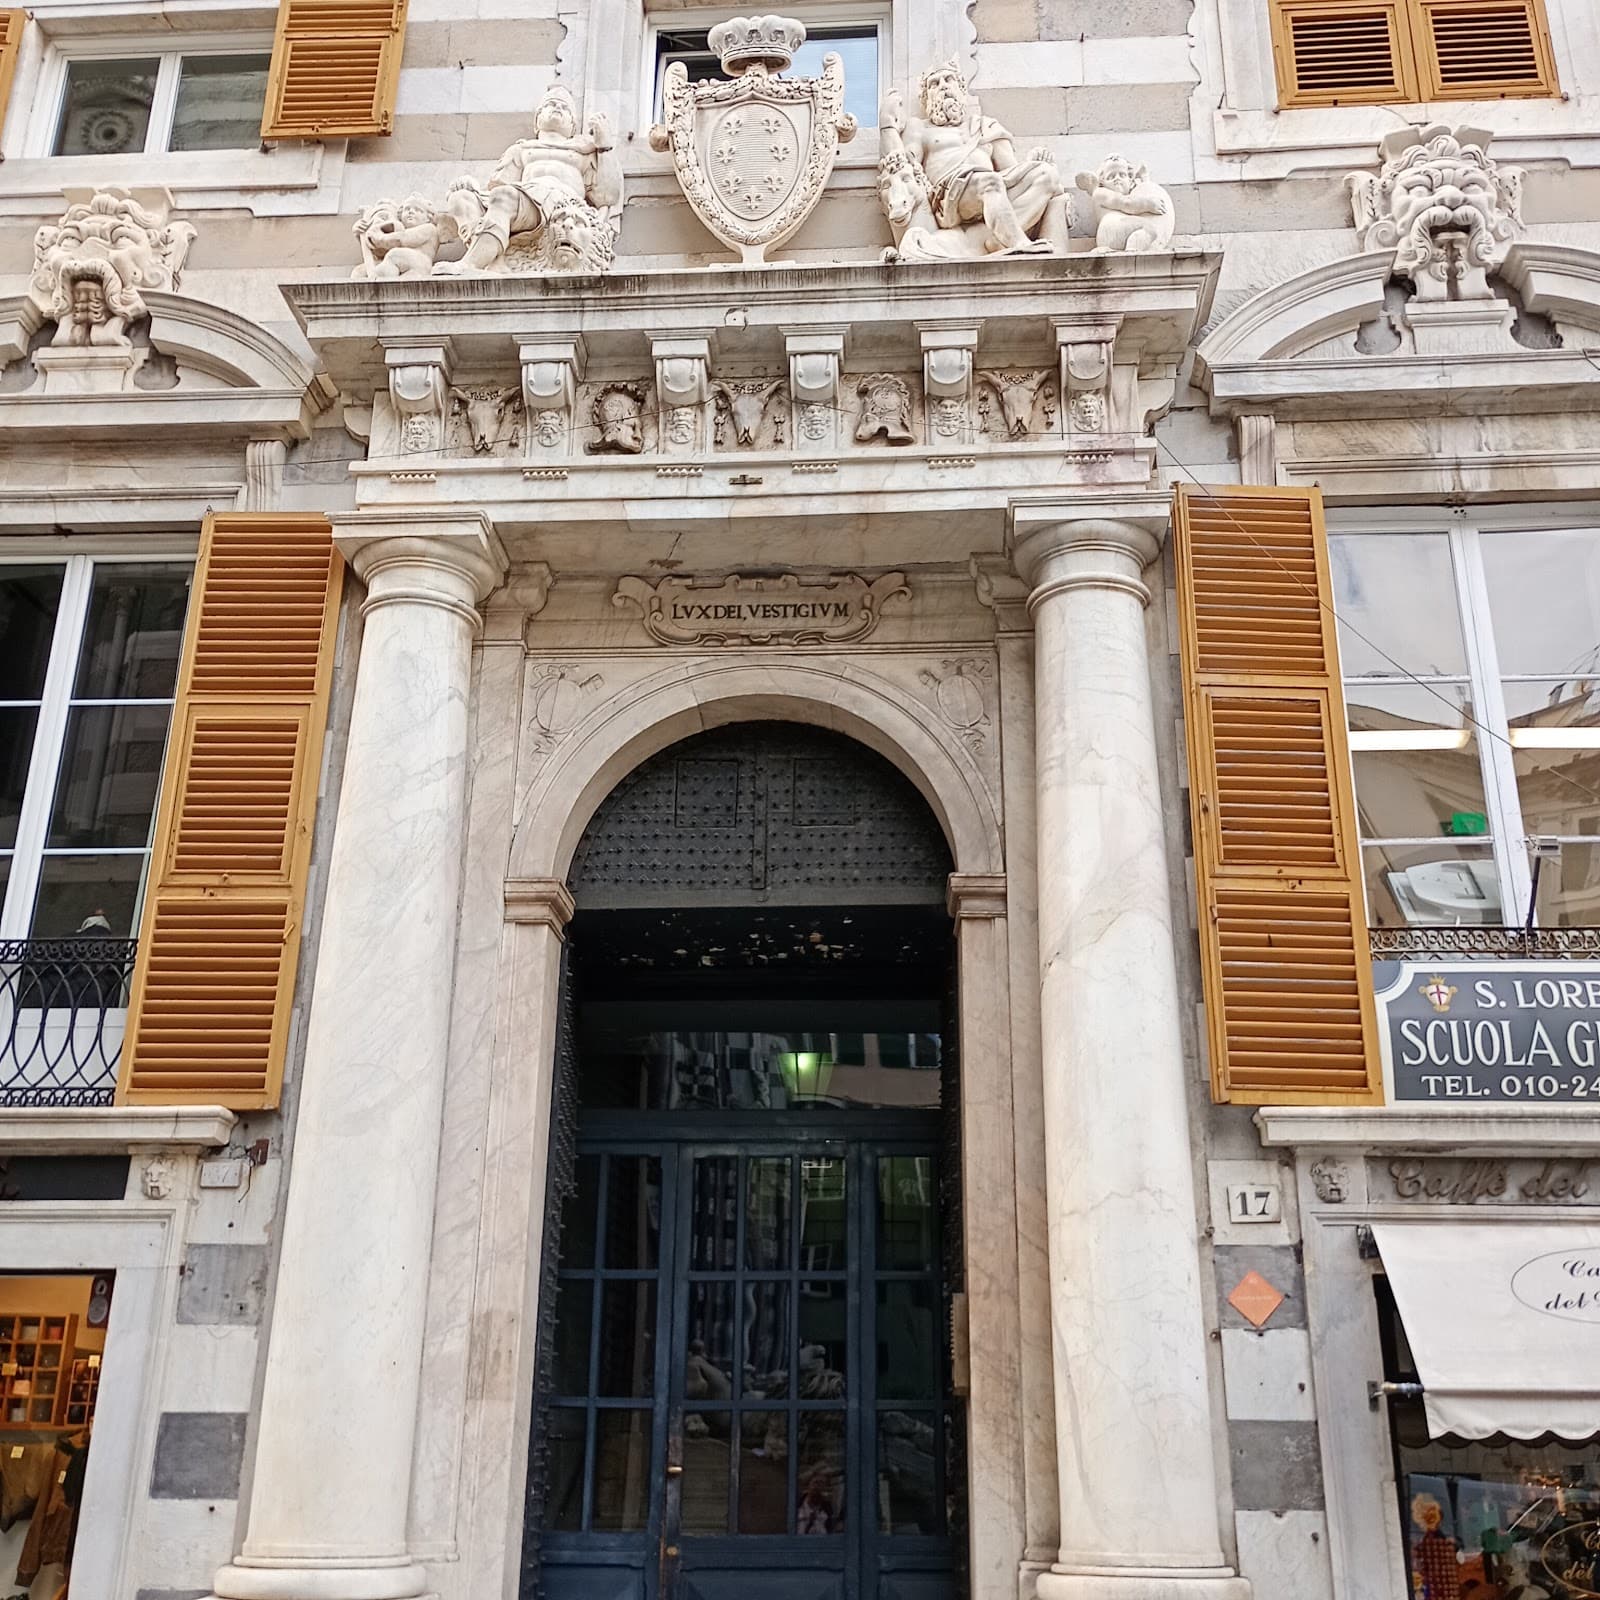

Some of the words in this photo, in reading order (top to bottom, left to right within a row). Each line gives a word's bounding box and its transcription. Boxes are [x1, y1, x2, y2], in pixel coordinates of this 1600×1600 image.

[1474, 980, 1507, 1009] S.
[1400, 1019, 1563, 1067] SCUOLA
[1566, 1020, 1600, 1067] G
[1421, 1075, 1491, 1097] TEL.
[1520, 1158, 1588, 1199] del
[1235, 1191, 1271, 1217] 17
[1545, 1292, 1589, 1310] del
